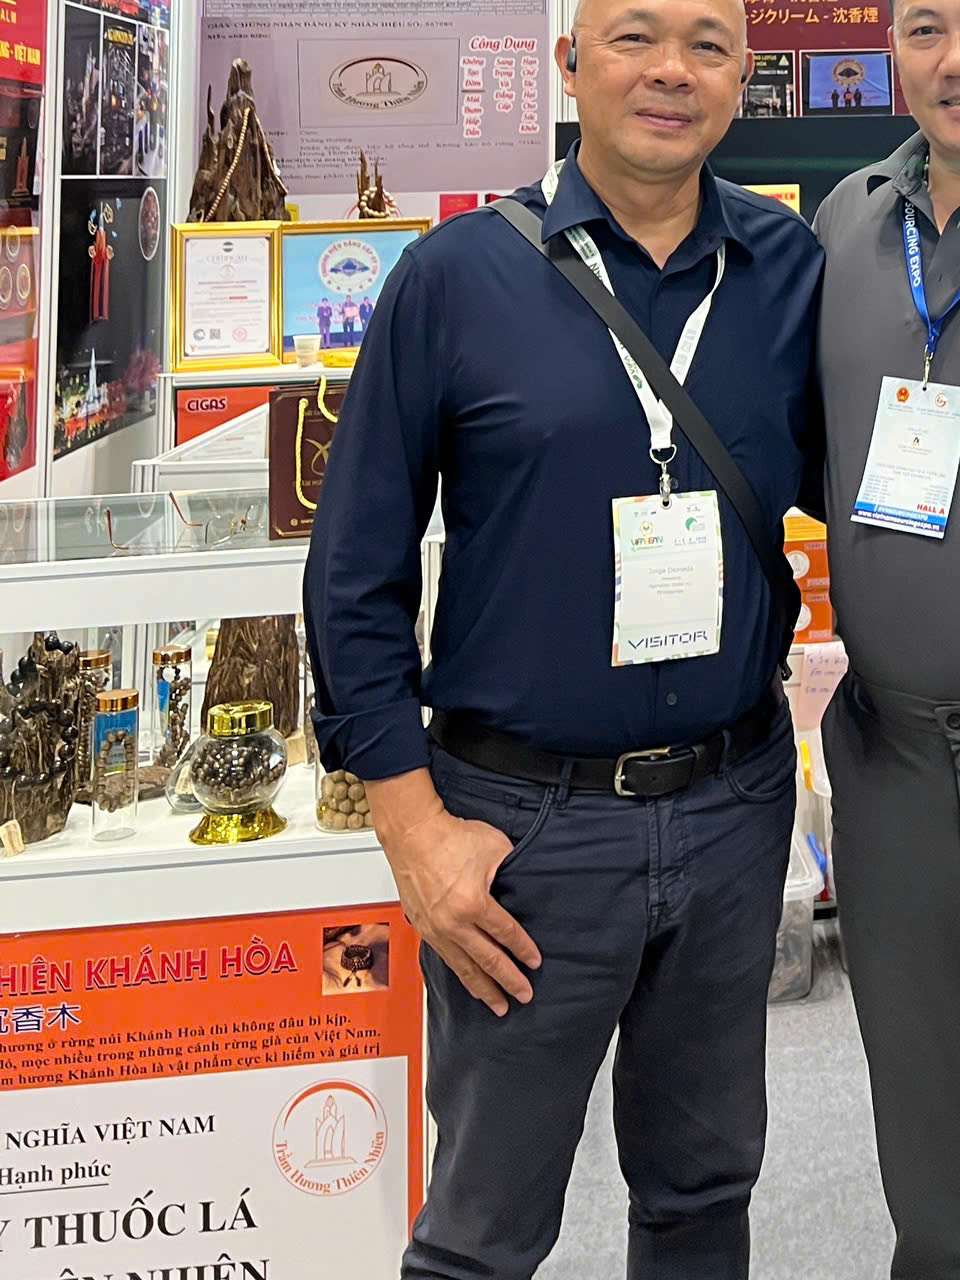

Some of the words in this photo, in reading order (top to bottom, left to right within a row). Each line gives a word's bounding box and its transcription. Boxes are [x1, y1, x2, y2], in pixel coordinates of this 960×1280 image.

[746, 8, 820, 24] ジクリーム
[470, 36, 501, 52] Công
[503, 36, 536, 52] Dụng
[904, 201, 920, 255] SOURCING
[910, 256, 921, 288] EXPO
[916, 502, 938, 514] HALL
[938, 507, 945, 515] A
[627, 630, 708, 650] VISITOR
[0, 955, 73, 999] HIÊN
[85, 944, 208, 991] KHÁNH
[219, 935, 299, 979] HÒA
[99, 1032, 122, 1046] núi
[126, 1028, 173, 1043] Khánh
[210, 1023, 228, 1036] thì
[232, 1020, 275, 1034] không
[279, 1017, 304, 1029] đâu
[21, 1058, 51, 1070] mọc
[54, 1049, 93, 1065] nhiều
[97, 1051, 135, 1065] trong
[139, 1045, 184, 1060] những
[187, 1040, 219, 1054] cánh
[314, 1028, 340, 1043] Việt
[345, 1026, 382, 1041] Nam.
[19, 1071, 64, 1086] hương
[68, 1067, 115, 1082] Khánh
[119, 1063, 148, 1077] Hòa
[152, 1061, 164, 1074] là
[168, 1059, 190, 1074] vật
[194, 1055, 233, 1073] phẩm
[282, 1046, 315, 1061] hiếm
[320, 1045, 335, 1058] và
[339, 1043, 359, 1059] giá
[5, 1123, 87, 1151] NGHĨA
[94, 1116, 153, 1146] VIỆT
[158, 1114, 216, 1137] NAM
[61, 1158, 112, 1184] phúc
[25, 1189, 187, 1251] THUỐC
[198, 1186, 259, 1234] LÁ
